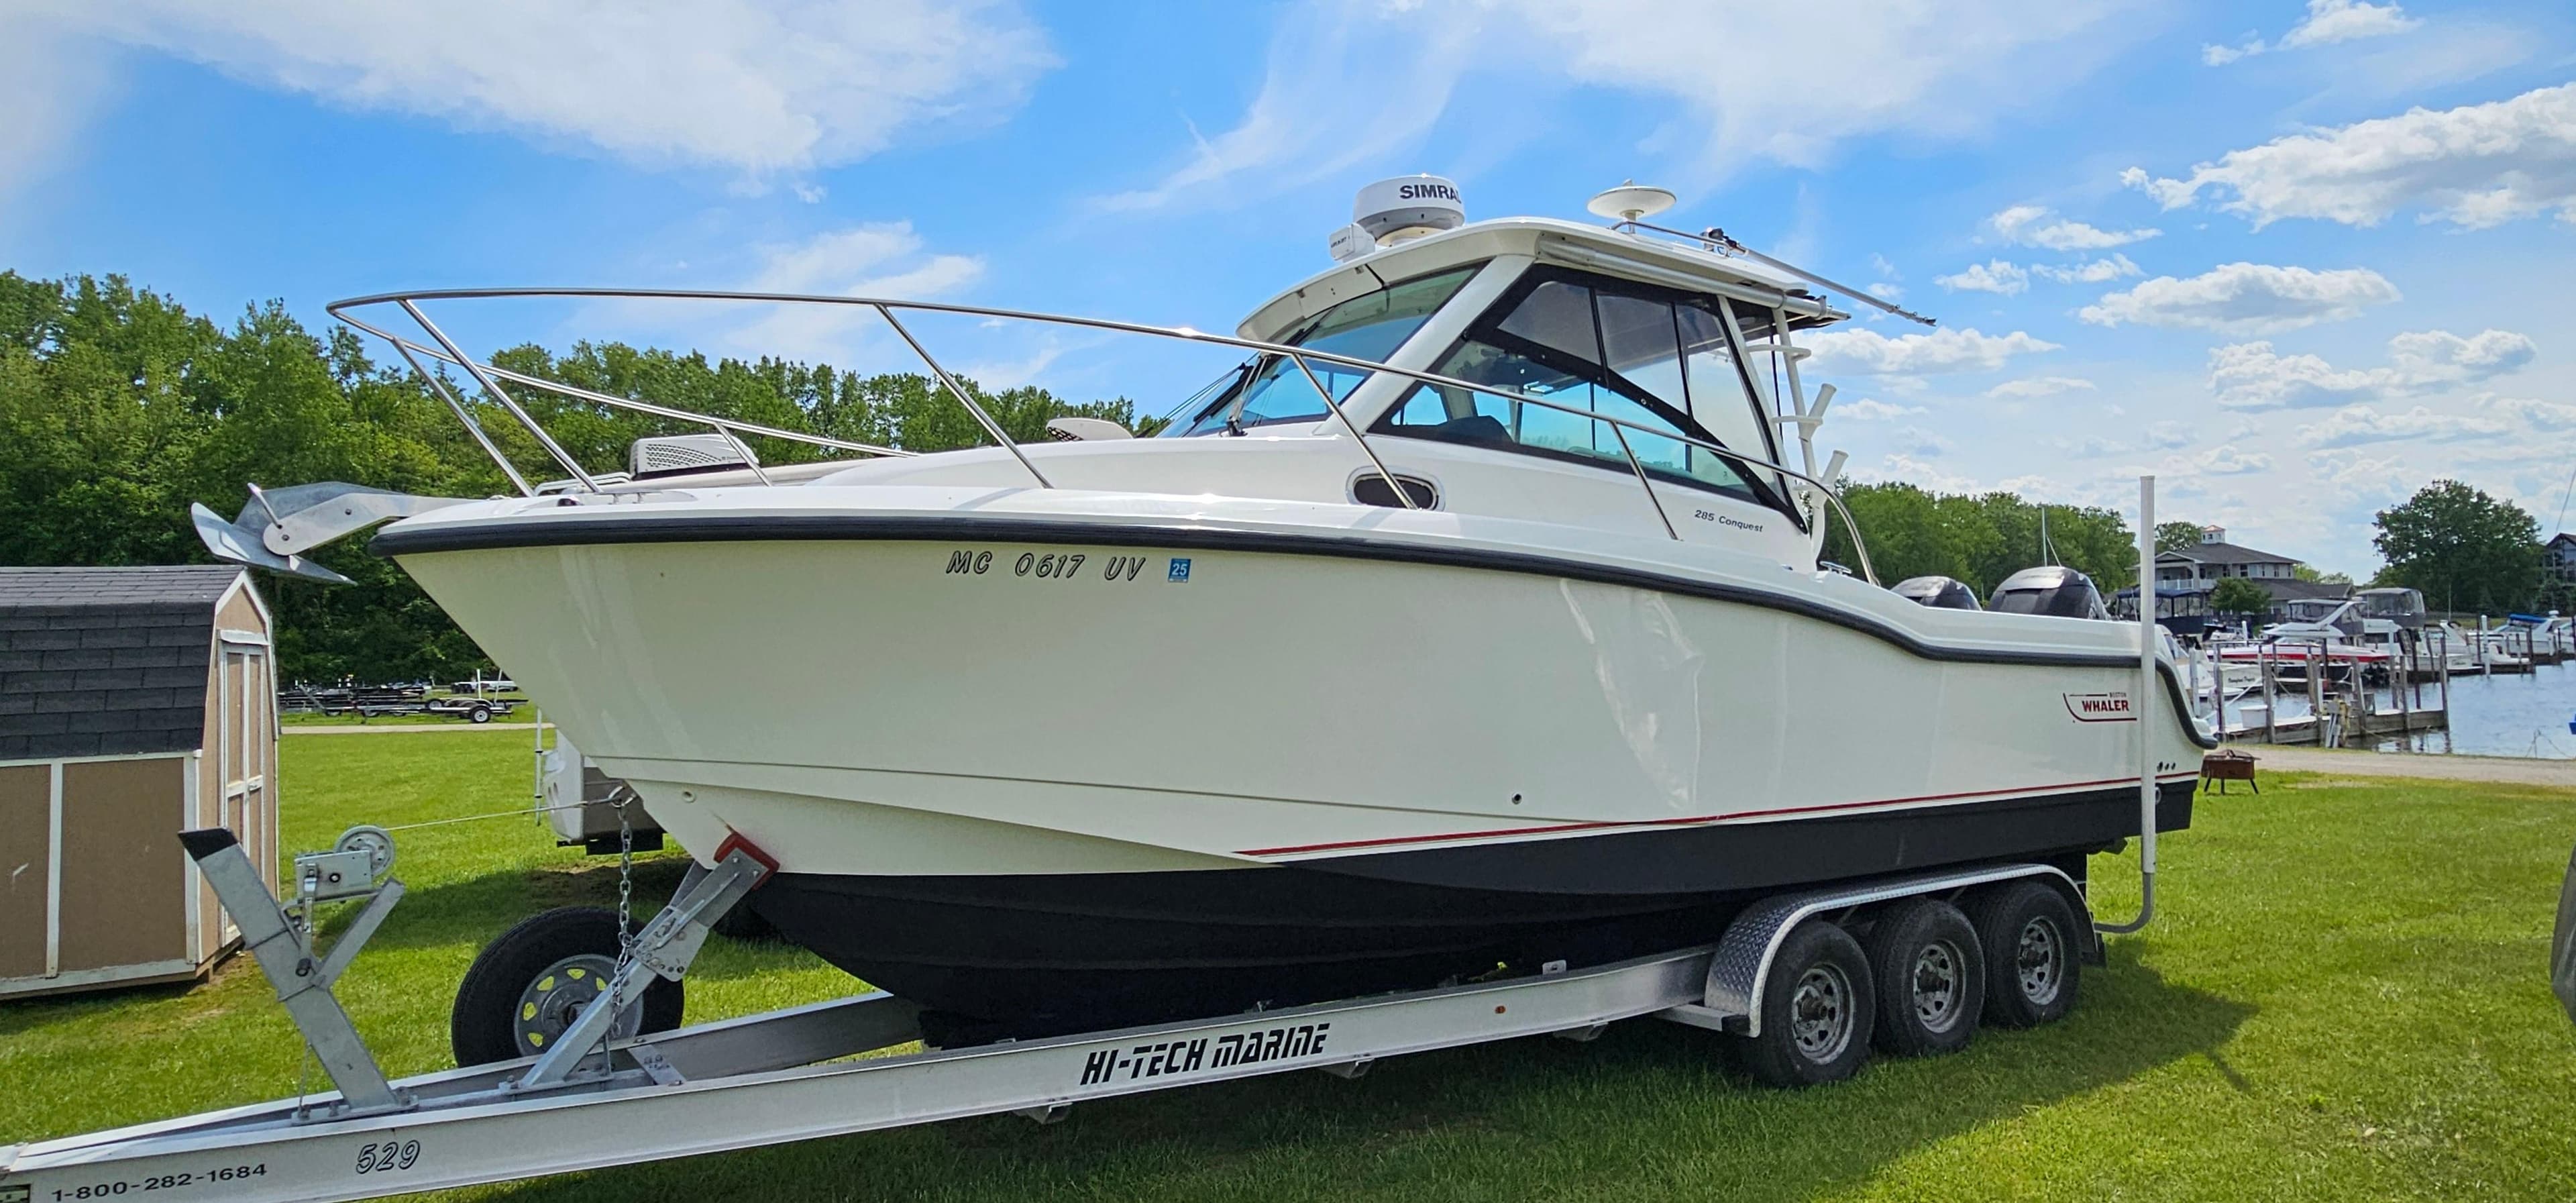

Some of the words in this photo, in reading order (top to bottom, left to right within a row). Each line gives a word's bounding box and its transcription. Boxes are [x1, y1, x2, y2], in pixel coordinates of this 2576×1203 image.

[1399, 185, 1462, 204] SIMRA
[1694, 510, 1715, 521] 285
[1719, 516, 1763, 532] Conquest
[946, 550, 992, 574] MC
[1015, 553, 1085, 578] 0617
[1104, 557, 1146, 581] UV
[1172, 563, 1187, 576] 25
[2082, 700, 2129, 713] WHALER
[1080, 1039, 1208, 1086] HI-TECH
[1211, 1023, 1330, 1069] MARINE
[356, 1139, 421, 1174] 529
[52, 1163, 267, 1202] 1-800-282-1684
